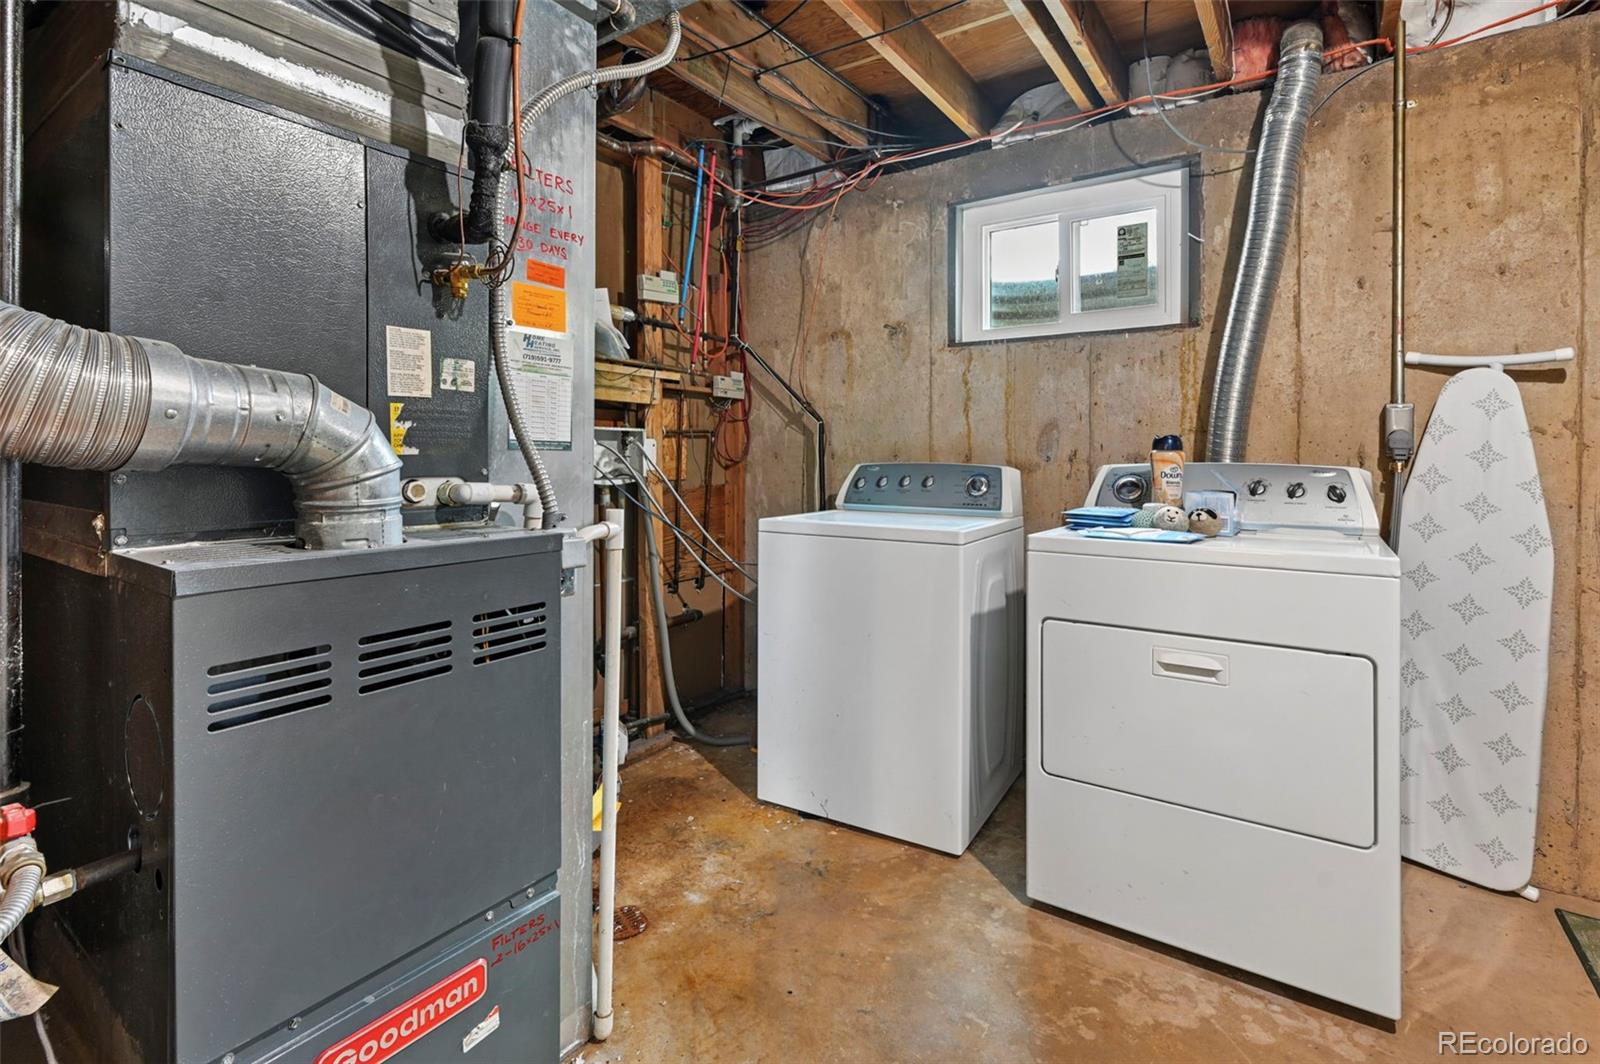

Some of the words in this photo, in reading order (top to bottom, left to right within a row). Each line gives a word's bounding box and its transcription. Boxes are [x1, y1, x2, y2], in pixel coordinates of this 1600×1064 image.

[516, 236, 534, 252] 30
[540, 241, 568, 260] DAYS
[549, 227, 585, 247] EVERY
[1160, 471, 1184, 480] Down
[490, 913, 545, 951] FILTERS
[333, 976, 478, 1064] Goodman
